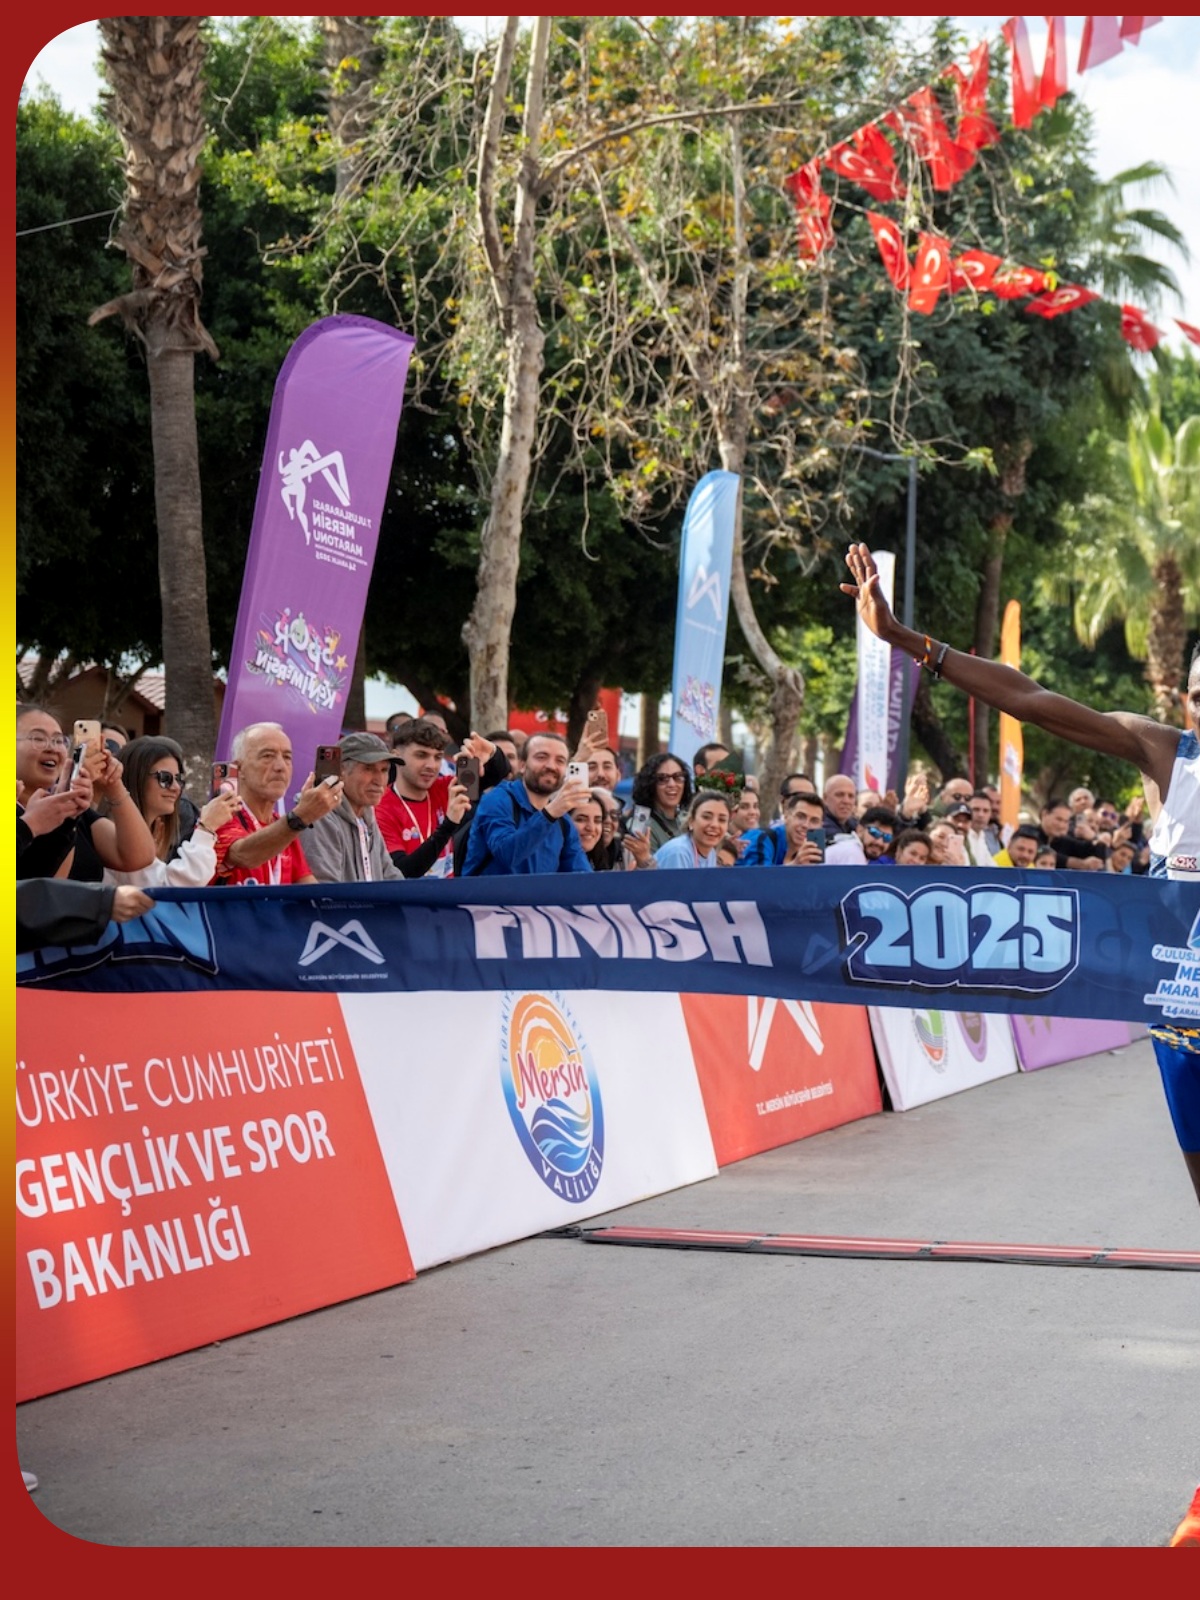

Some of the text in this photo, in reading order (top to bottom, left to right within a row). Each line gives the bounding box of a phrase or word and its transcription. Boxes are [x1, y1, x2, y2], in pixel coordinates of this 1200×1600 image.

[458, 900, 774, 968] FINISH
[855, 887, 1075, 975] 2025
[1165, 1005, 1178, 1015] 14
[144, 1026, 345, 1107] CUMHURİYETİ
[16, 1110, 336, 1219] GENÇLİK VE SPOR
[26, 1196, 251, 1310] BAKANLIĞI
